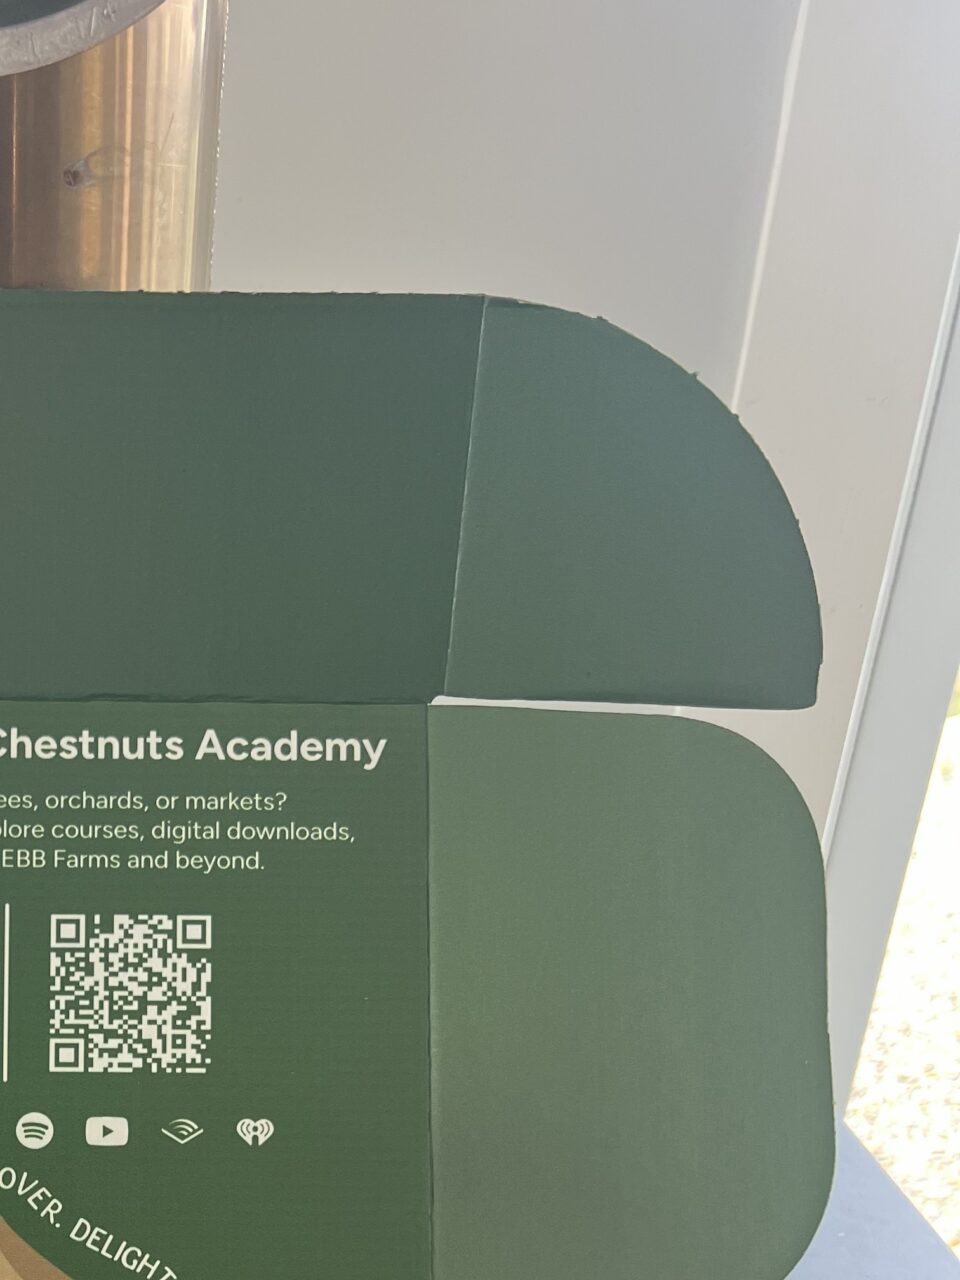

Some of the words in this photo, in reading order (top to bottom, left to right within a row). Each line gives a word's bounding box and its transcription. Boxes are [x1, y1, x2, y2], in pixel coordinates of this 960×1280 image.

[195, 729, 387, 770] Academy
[45, 790, 148, 812] orchards,
[156, 796, 179, 809] or
[186, 791, 287, 811] markets?
[52, 824, 144, 841] courses,
[152, 820, 219, 844] digital
[227, 821, 354, 843] downloads,
[2, 849, 46, 868] EBB
[54, 849, 120, 868] Farms
[128, 850, 168, 869] and
[176, 850, 264, 874] beyond.
